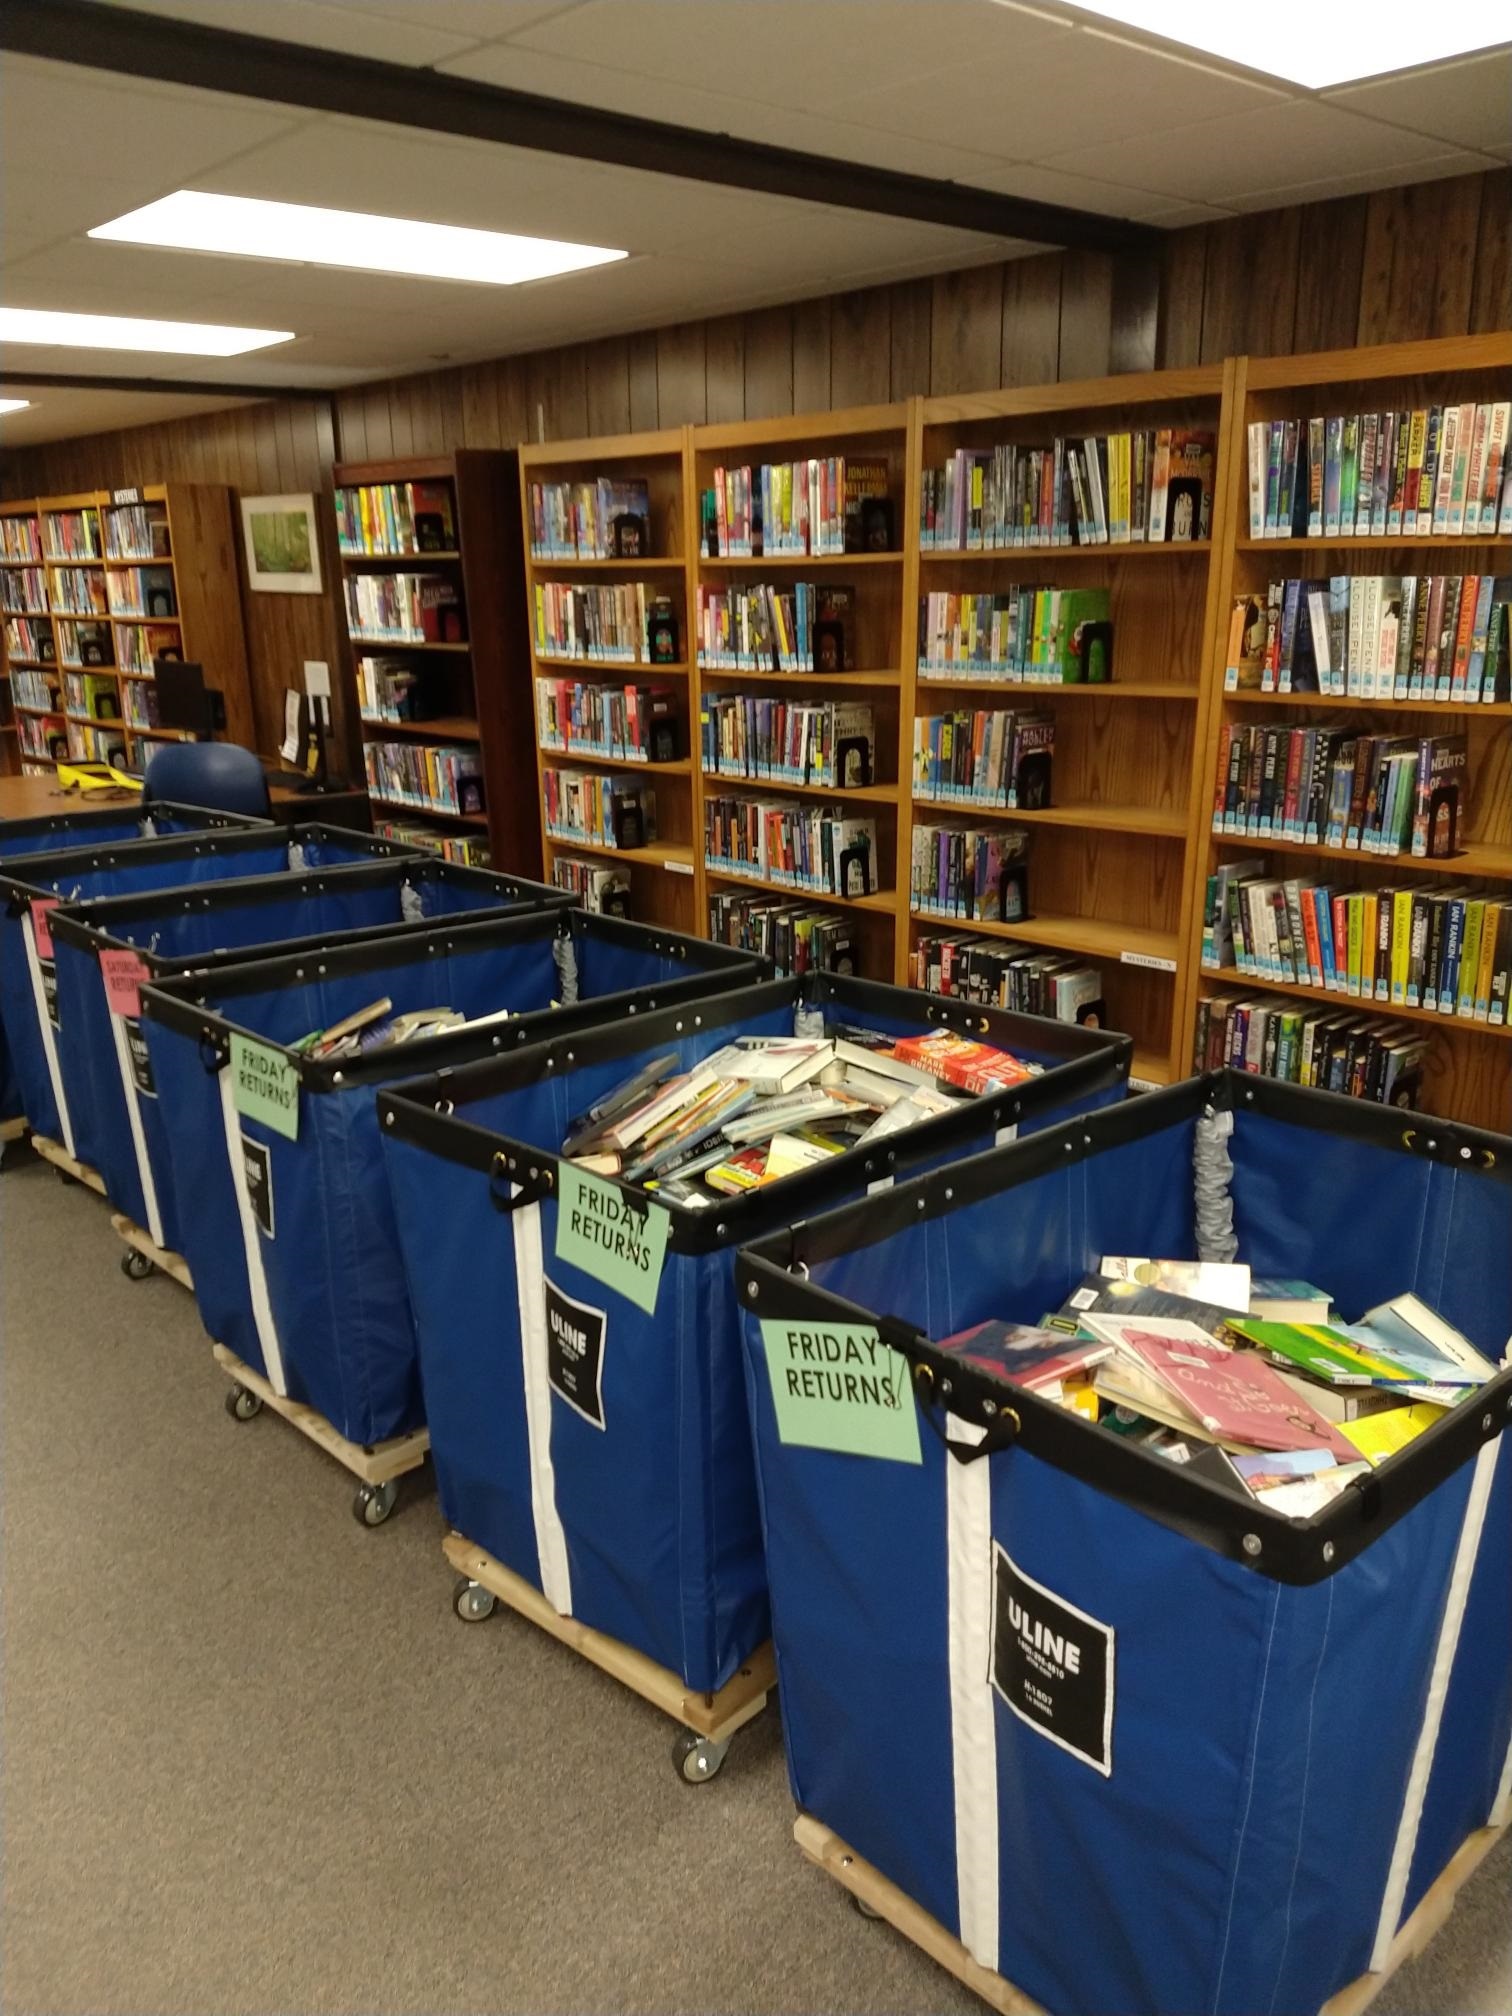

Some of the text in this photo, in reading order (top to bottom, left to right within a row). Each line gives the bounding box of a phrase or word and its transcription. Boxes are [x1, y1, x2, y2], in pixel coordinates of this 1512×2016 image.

[1493, 409, 1505, 440] SWIFT
[1352, 586, 1360, 629] LOUISE
[1416, 581, 1428, 643] ANNE PERRY
[1459, 581, 1473, 643] ANNE PERRY
[1364, 586, 1376, 674] LOUISE PENN
[1488, 608, 1501, 651] ANNE PERRY
[1265, 735, 1277, 779] ANNE PERRY
[1312, 736, 1323, 780] PERRY
[1320, 741, 1328, 777] ANNE
[1431, 753, 1466, 772] HEARTS
[1430, 776, 1441, 789] OF
[1287, 886, 1303, 949] DRY BONES
[1380, 915, 1389, 950] RANKIN
[1396, 917, 1404, 949] RANKIN
[1411, 921, 1421, 957] RANKIN
[1447, 906, 1459, 959] IAN RANKIN
[1465, 907, 1478, 960] IAN RANKIN
[1483, 912, 1494, 965] IAN RANKIN
[242, 1047, 287, 1082] FRIDAY
[920, 1055, 944, 1070] MARK
[239, 1071, 291, 1109] RETURNS
[578, 1183, 648, 1236] FRIDAY
[571, 1210, 650, 1272] RETURNS
[550, 1308, 587, 1356] ULINE
[786, 1331, 878, 1366] FRIDAY
[786, 1368, 896, 1409] RETURNS
[1008, 1595, 1081, 1675] ULINE
